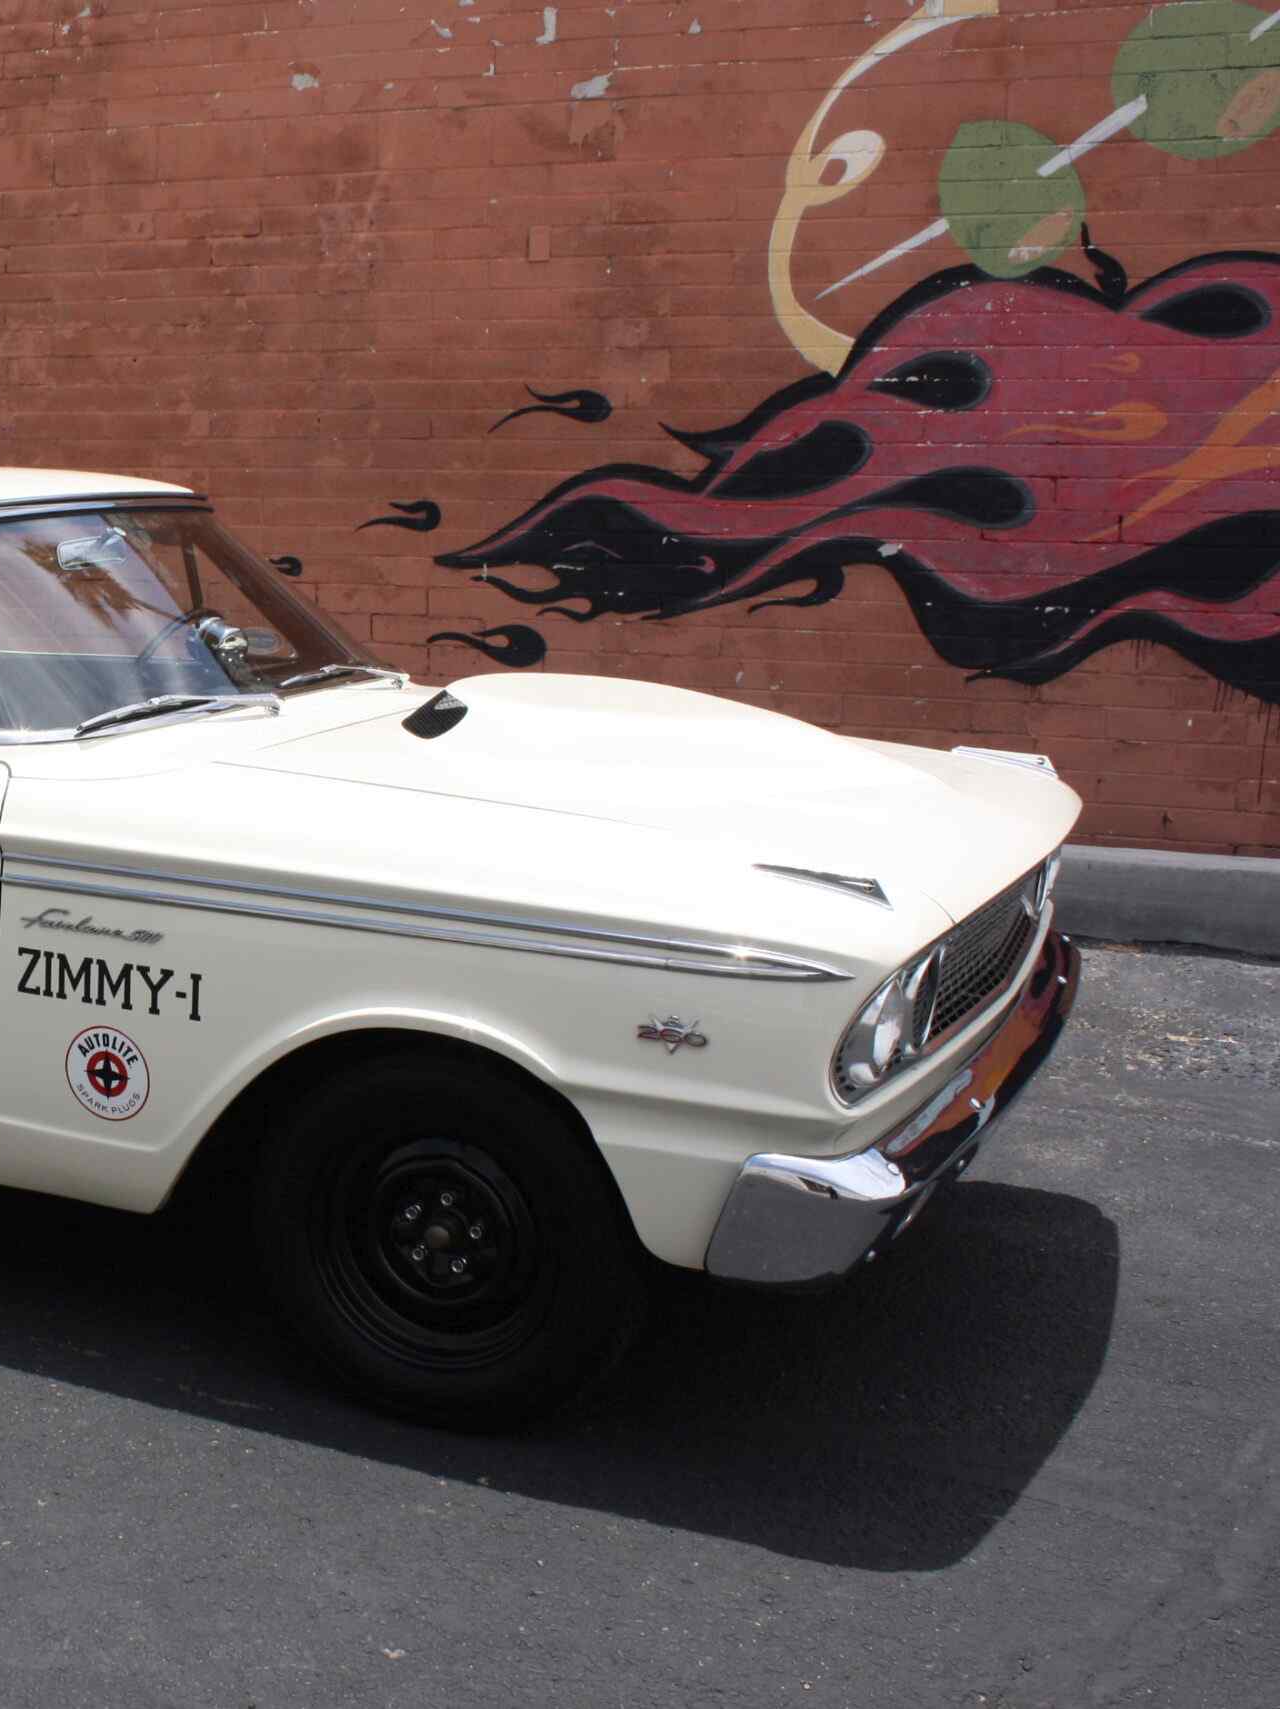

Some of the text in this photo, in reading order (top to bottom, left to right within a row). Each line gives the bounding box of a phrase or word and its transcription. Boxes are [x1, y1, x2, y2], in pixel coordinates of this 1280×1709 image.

[77, 1033, 139, 1066] AUTOLITE
[76, 1083, 140, 1114] SPARK PLUGS
